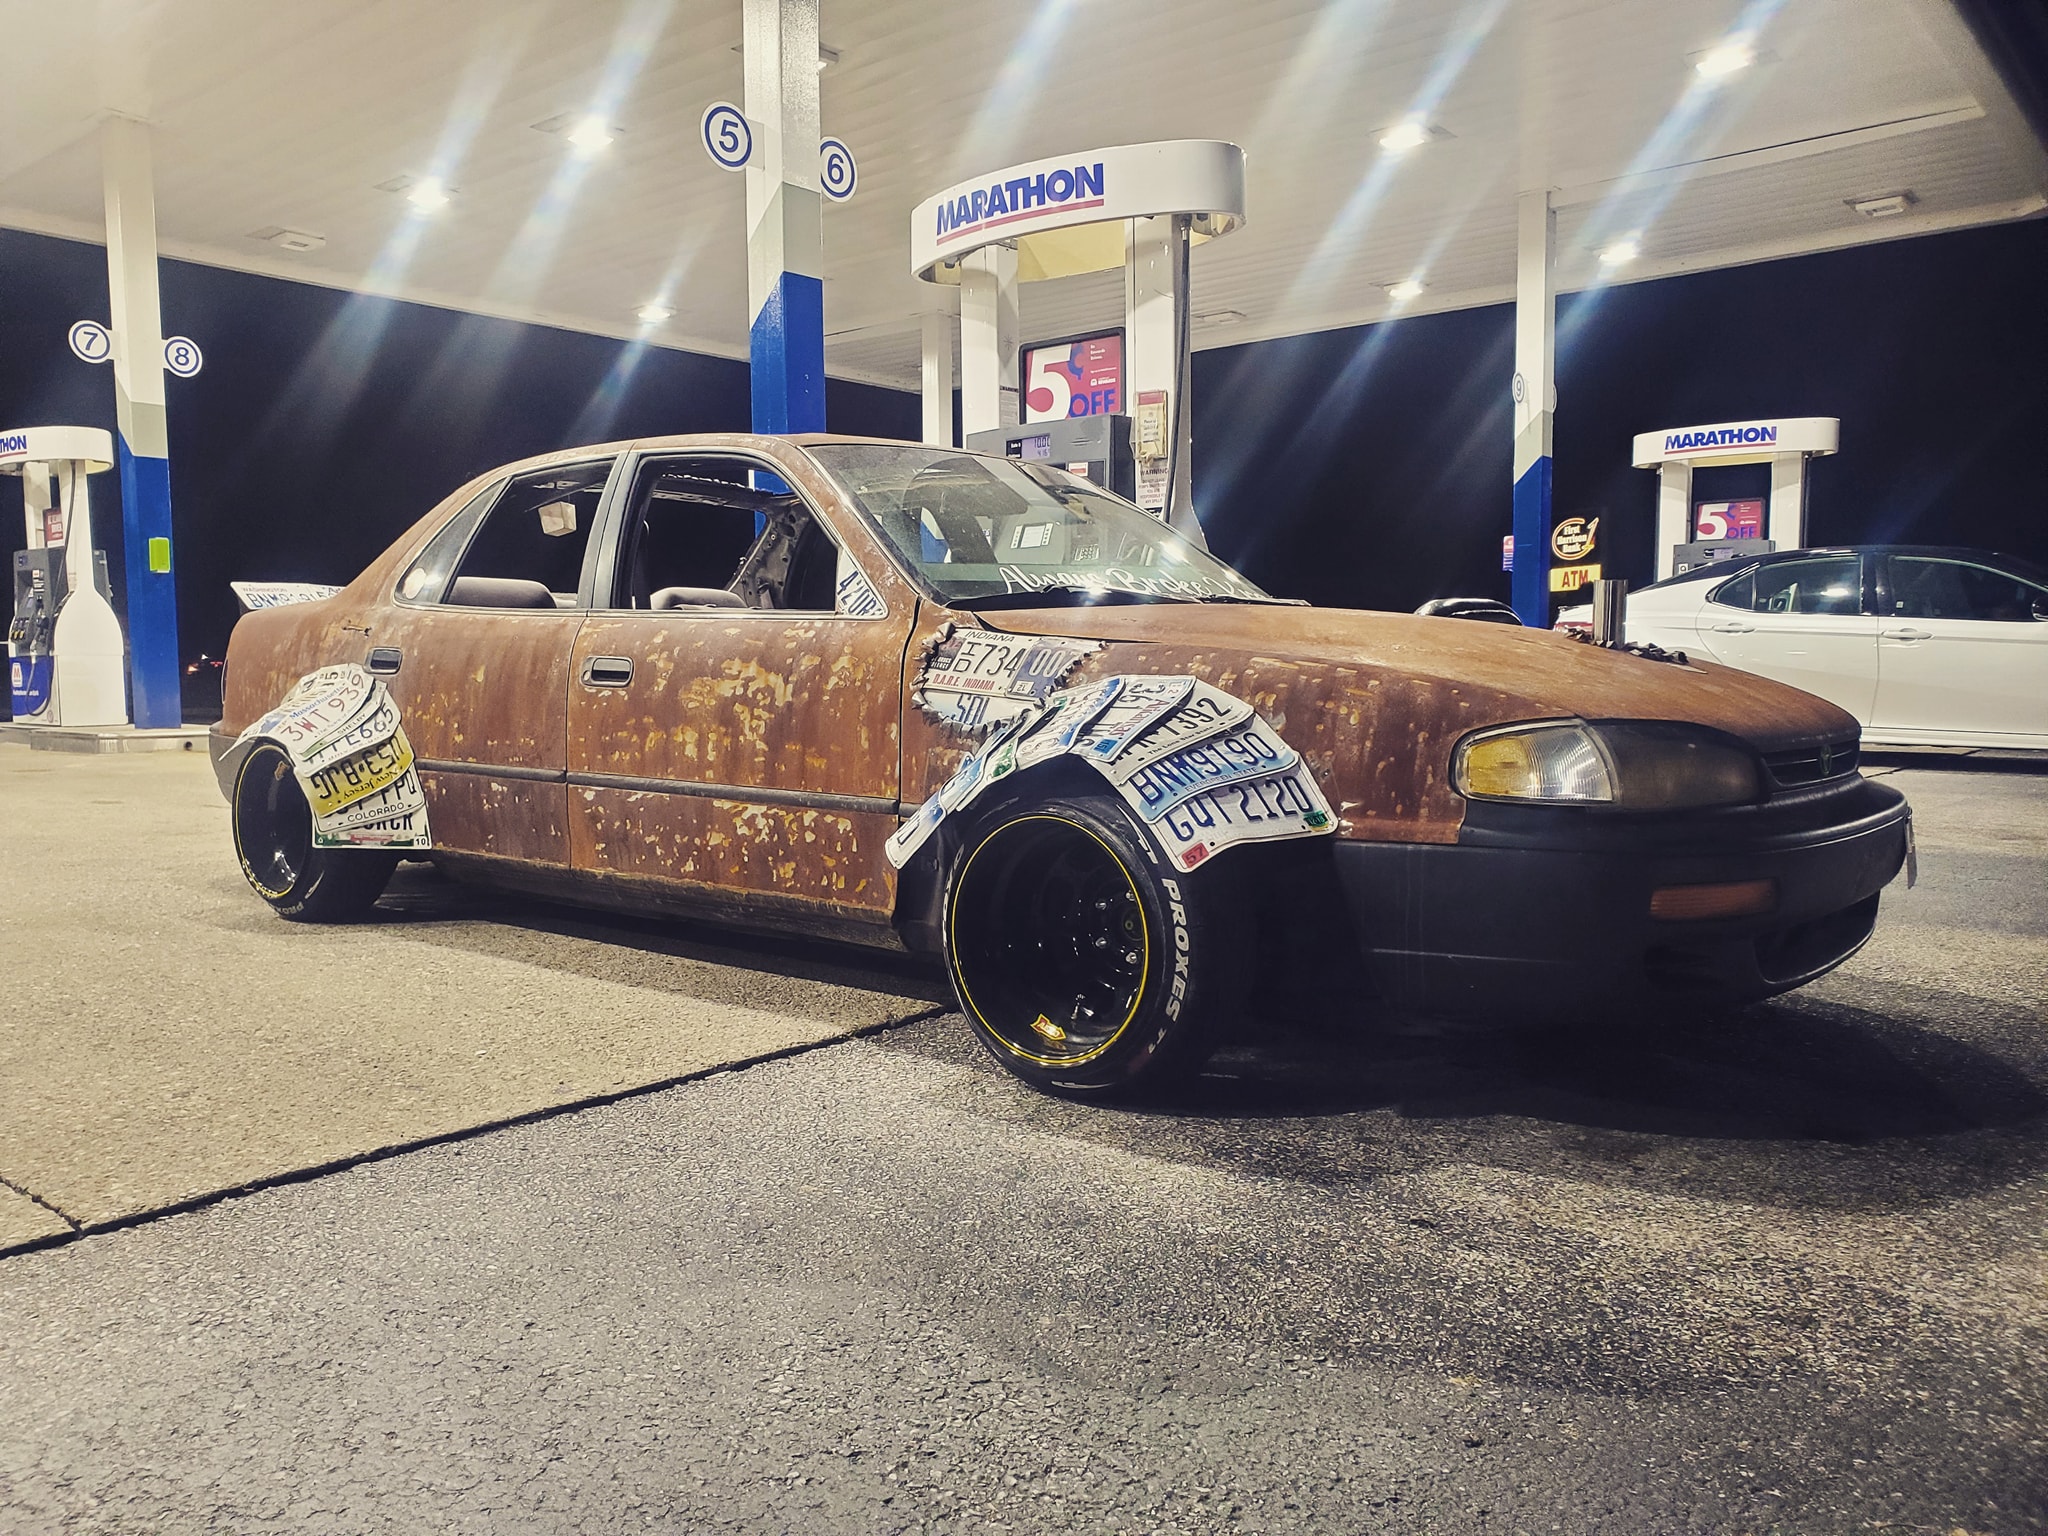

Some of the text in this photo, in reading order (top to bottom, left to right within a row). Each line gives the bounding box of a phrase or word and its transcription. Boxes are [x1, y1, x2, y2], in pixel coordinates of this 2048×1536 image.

[719, 119, 739, 153] 5
[827, 153, 844, 184] 6
[937, 163, 1104, 236] MARATHON
[83, 331, 98, 351] 7
[174, 346, 190, 366] 8
[1070, 389, 1116, 418] OFF
[1665, 426, 1777, 450] MARATHON
[1557, 534, 1588, 545] Harrison
[1564, 525, 1580, 535] First
[1726, 526, 1756, 540] OFF
[1561, 569, 1588, 588] ATM
[965, 630, 1015, 643] INDIANA
[973, 643, 1027, 678] 734
[962, 678, 996, 691] INDIANA
[281, 707, 330, 743] 3WT
[328, 672, 365, 713] 939
[289, 683, 345, 719] Massachusetts
[337, 713, 367, 735] SHELBY
[1129, 731, 1278, 804] BNM9190
[343, 768, 398, 800] New Jersey
[1184, 767, 1259, 793] EVERGREEN STATE
[1228, 775, 1314, 823] 2120
[347, 802, 405, 823] COLORADO
[416, 838, 427, 846] 10
[1184, 847, 1207, 865] 57
[1161, 877, 1190, 1023] PROXES
